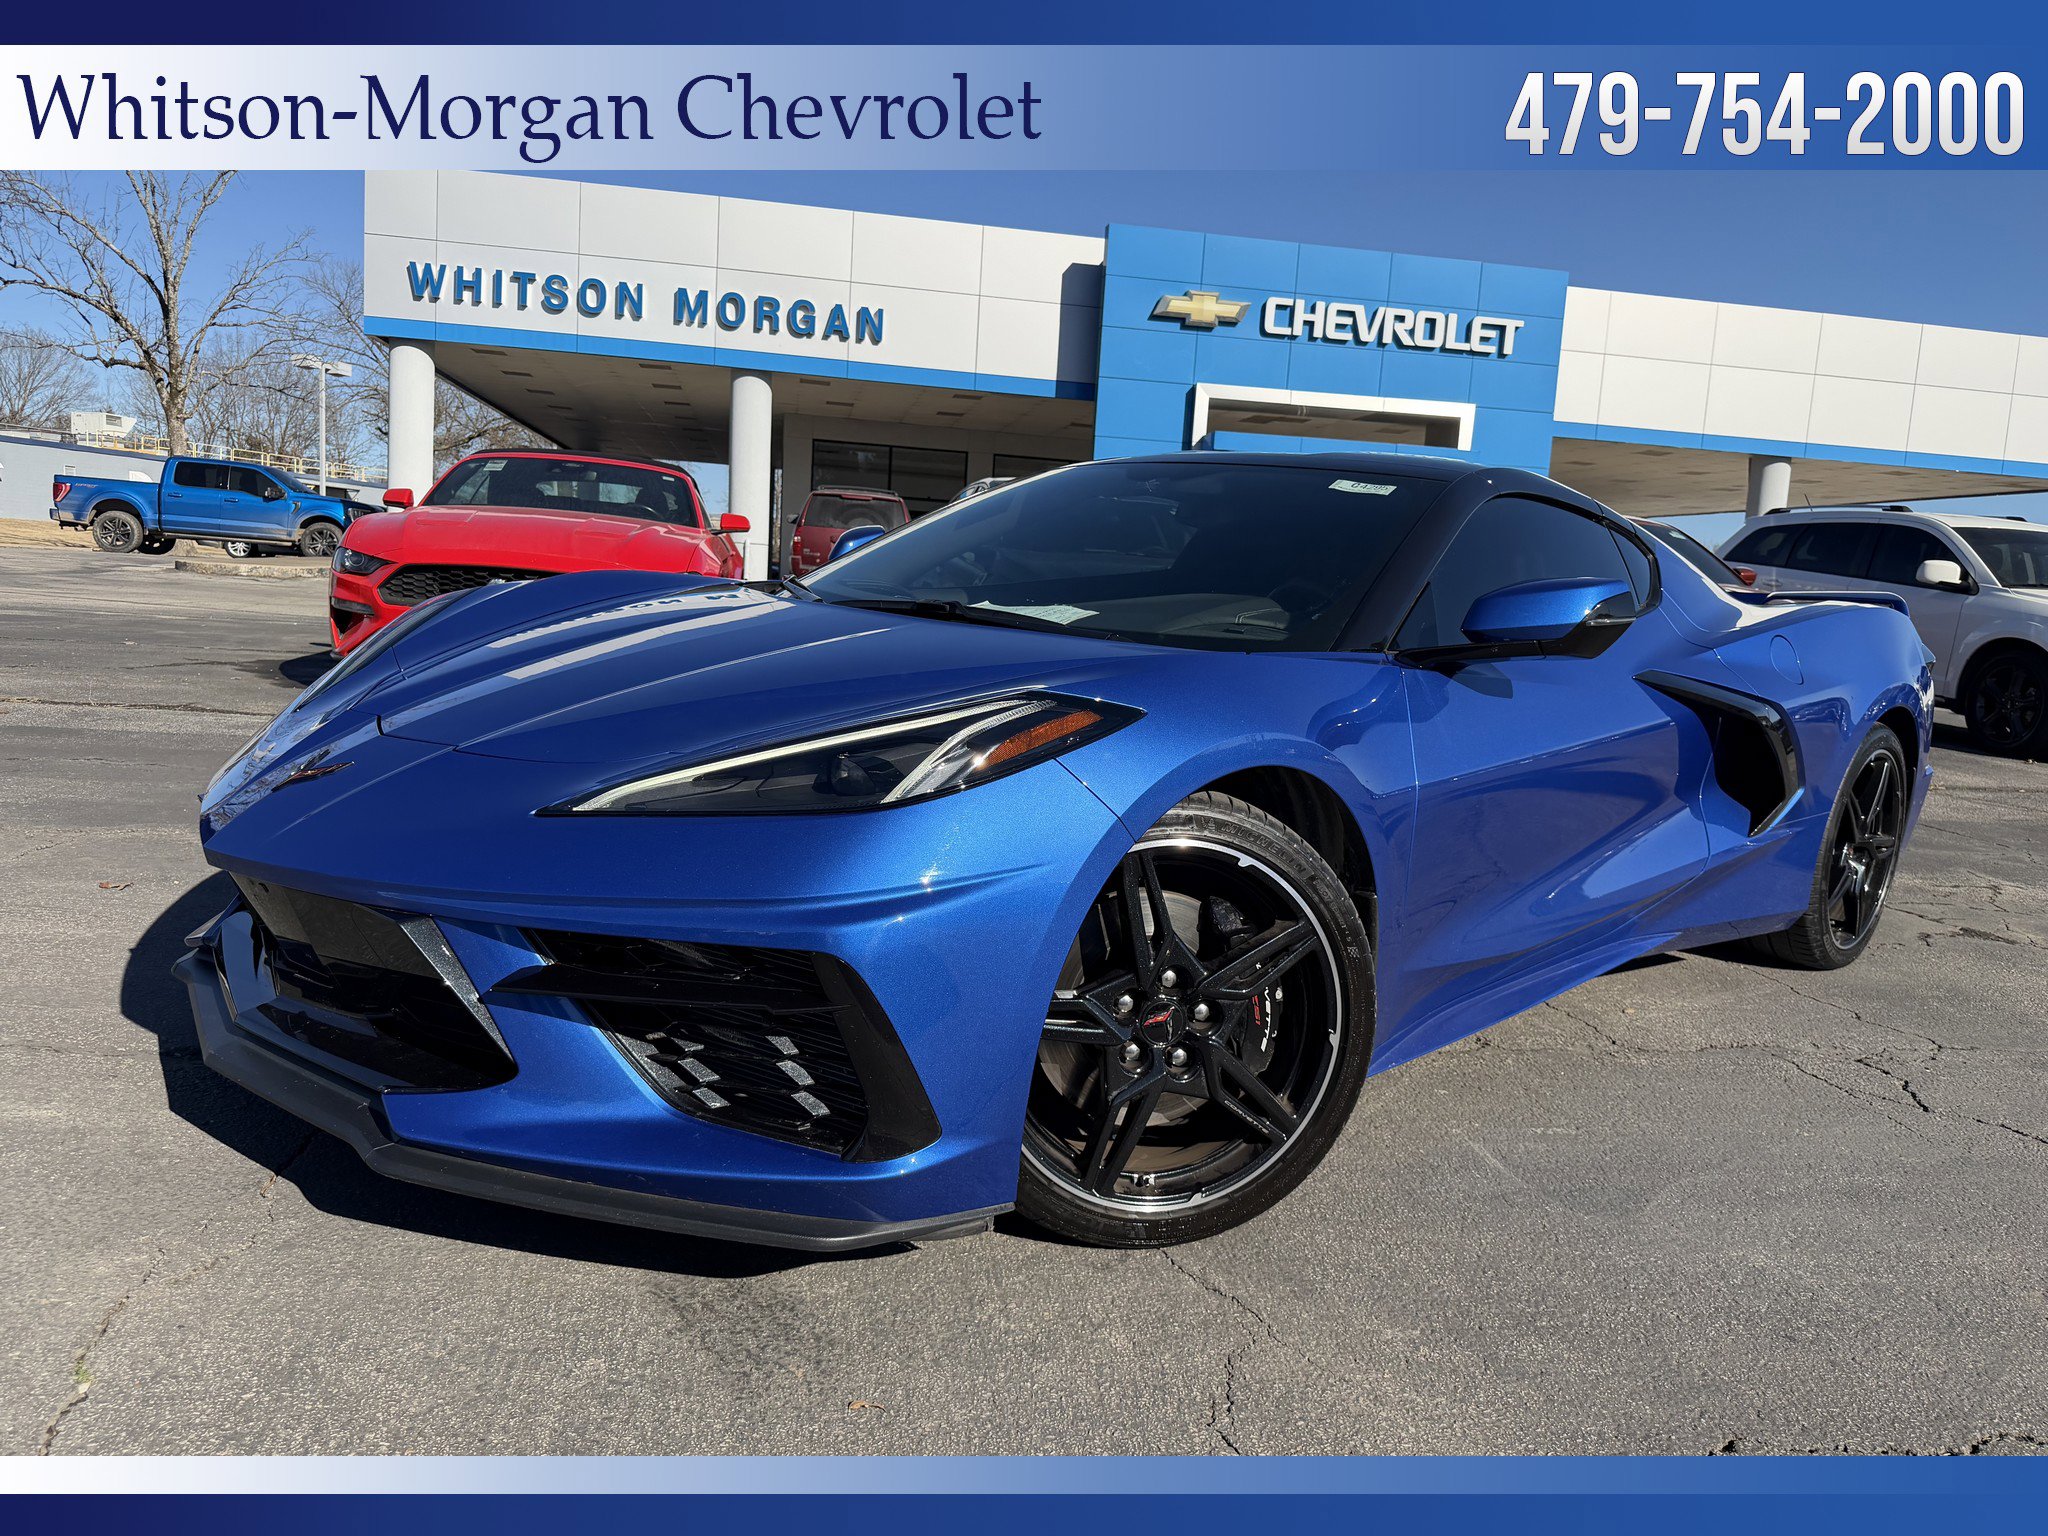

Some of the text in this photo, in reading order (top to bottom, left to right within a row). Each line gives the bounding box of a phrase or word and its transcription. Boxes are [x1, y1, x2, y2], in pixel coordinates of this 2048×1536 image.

[407, 261, 884, 346] WHITSON MORGAN
[1262, 296, 1525, 357] CHEVROLET
[1221, 821, 1307, 875] MICHELIN
[1224, 1100, 1270, 1134] CORVETTE
